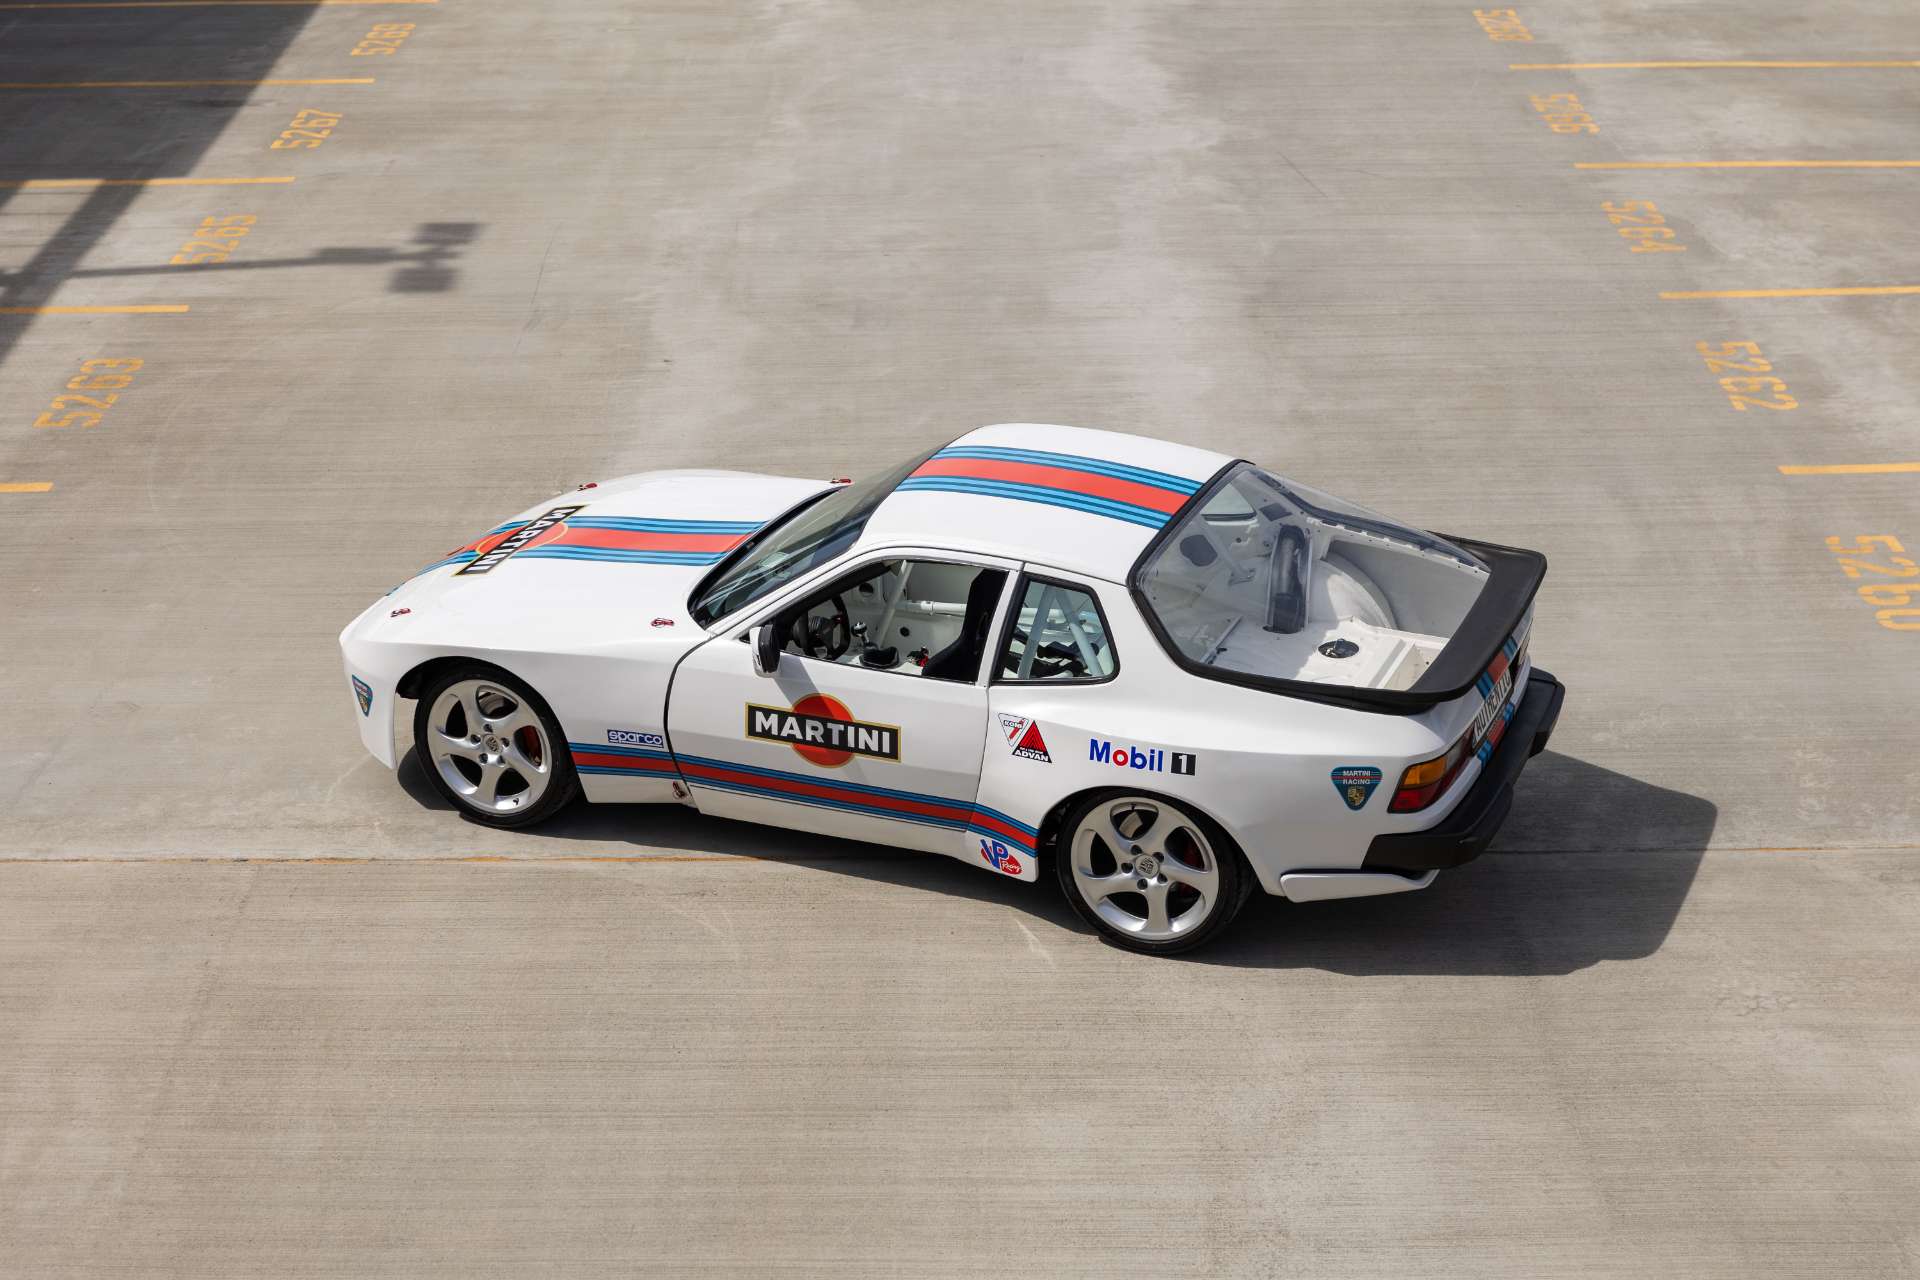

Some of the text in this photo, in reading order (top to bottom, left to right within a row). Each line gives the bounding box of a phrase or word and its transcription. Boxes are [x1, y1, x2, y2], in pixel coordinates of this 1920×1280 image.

[271, 108, 343, 150] 5267
[170, 214, 257, 264] 5265
[1600, 199, 1687, 253] 5264
[32, 358, 144, 428] 5263
[1696, 340, 1799, 411] 5262
[464, 507, 579, 572] MARTINI
[608, 730, 662, 745] sparco
[755, 710, 890, 754] MARTINI
[1014, 749, 1049, 762] ADVAN
[1089, 738, 1191, 775] Mobil 1
[980, 838, 1009, 870] VP
